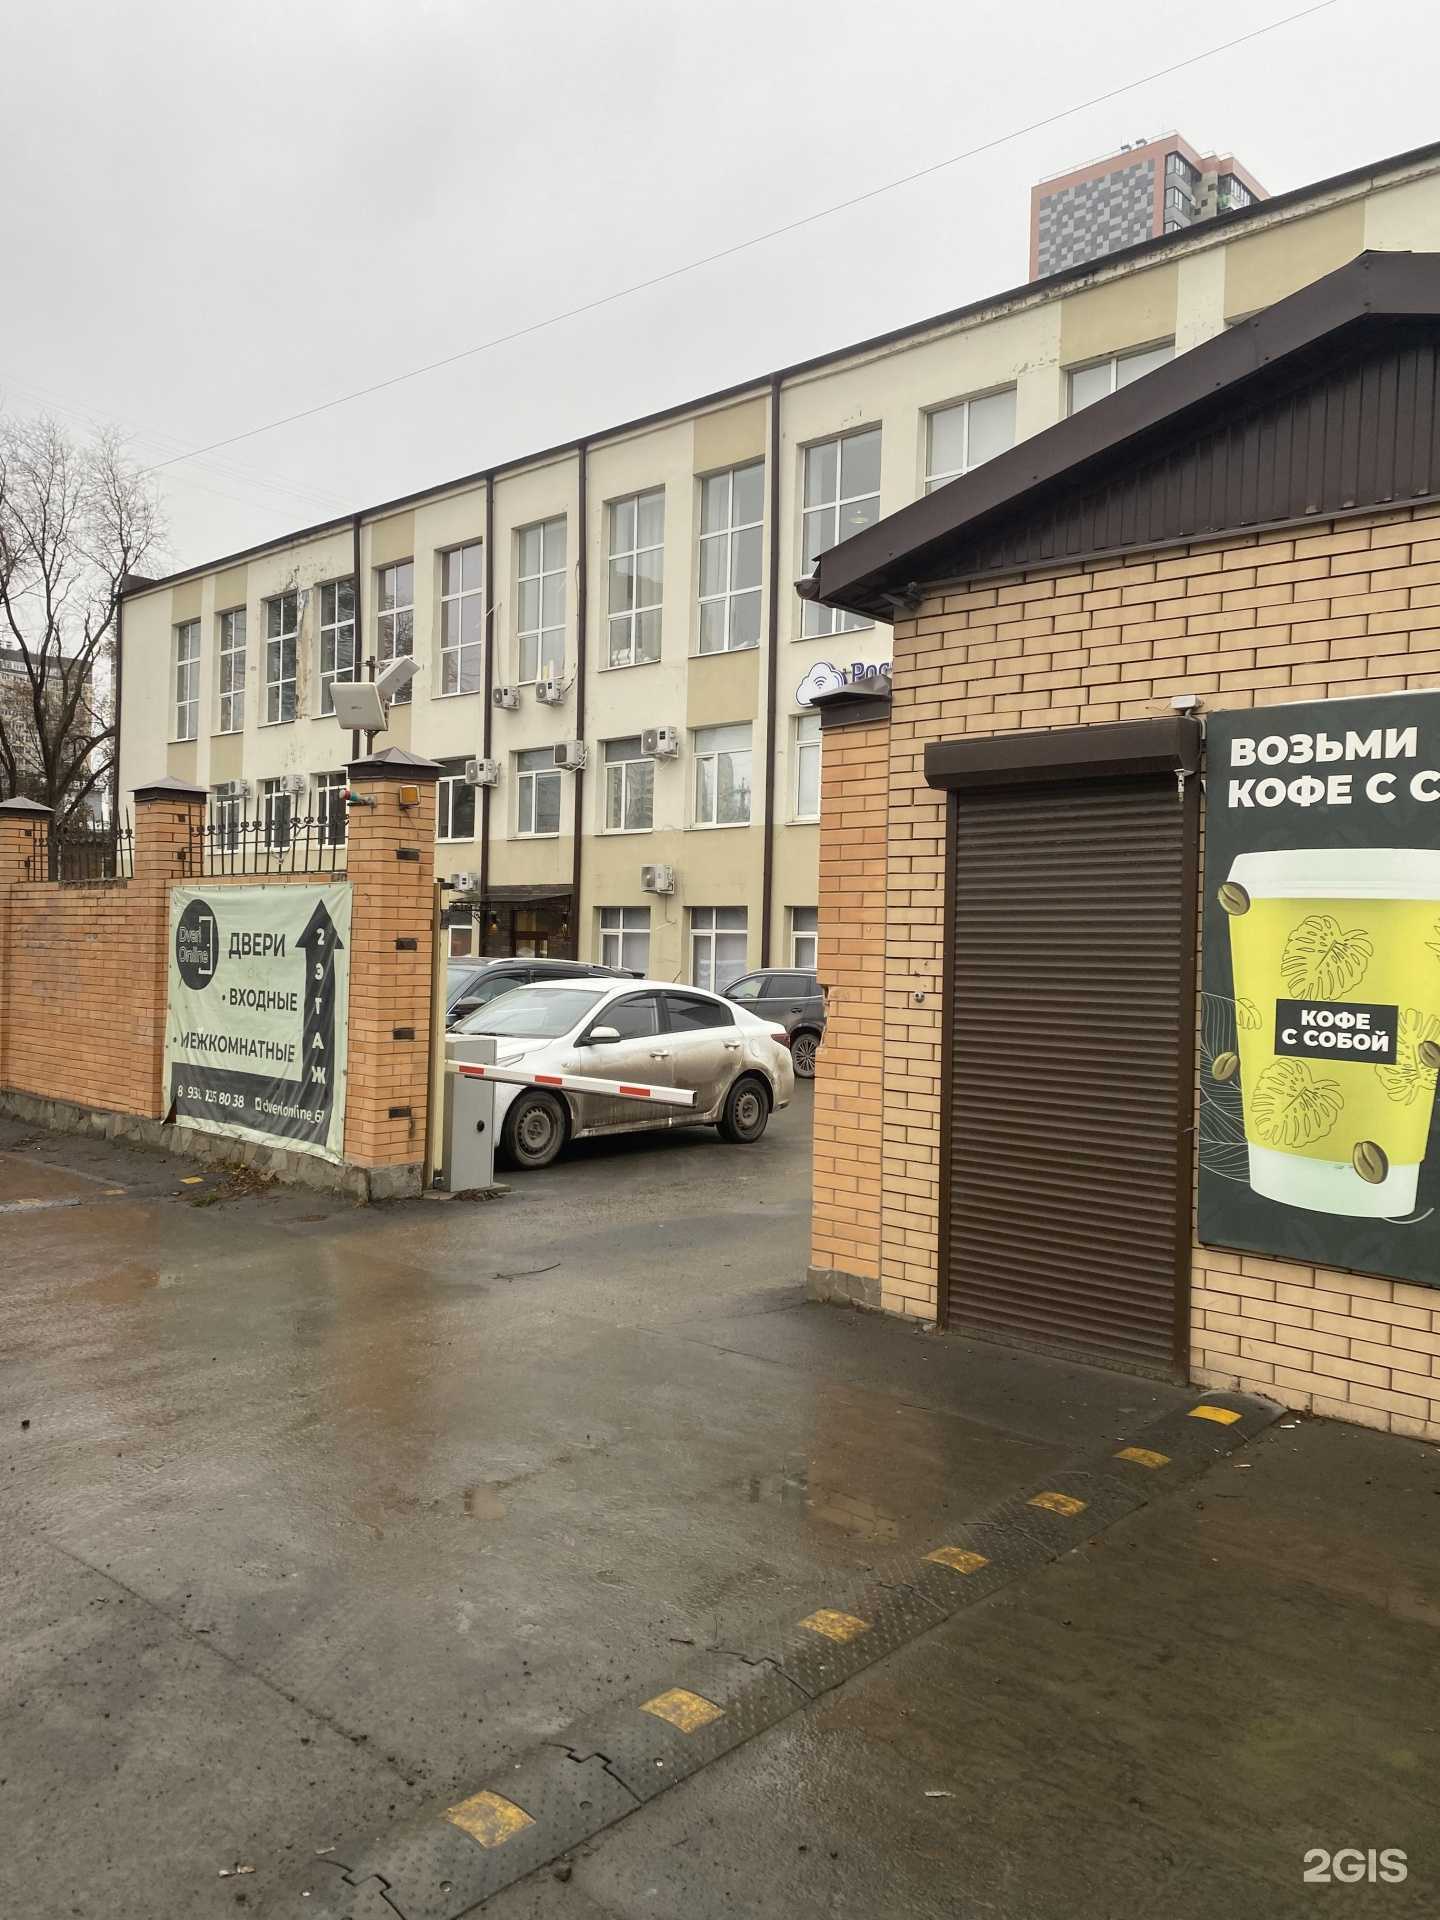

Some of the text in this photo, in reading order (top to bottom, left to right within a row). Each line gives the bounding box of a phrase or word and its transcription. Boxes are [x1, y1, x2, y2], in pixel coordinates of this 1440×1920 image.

[1231, 727, 1418, 767] ВОЗЬМИ
[1228, 775, 1353, 808] КОФЕ
[1365, 772, 1397, 804] С
[228, 932, 286, 960] ДВЕРИ
[229, 988, 298, 1012] ВХОДНЫЕ
[311, 928, 326, 1084] 2 ЭТАЖ
[1301, 1009, 1371, 1030] КОФЕ
[180, 1031, 296, 1063] МЕЖКОМНАТНЫЕ
[1281, 1028, 1390, 1052] С СОБОЙ
[177, 1084, 184, 1098] 8
[219, 1092, 231, 1106] 80
[232, 1094, 245, 1108] 38
